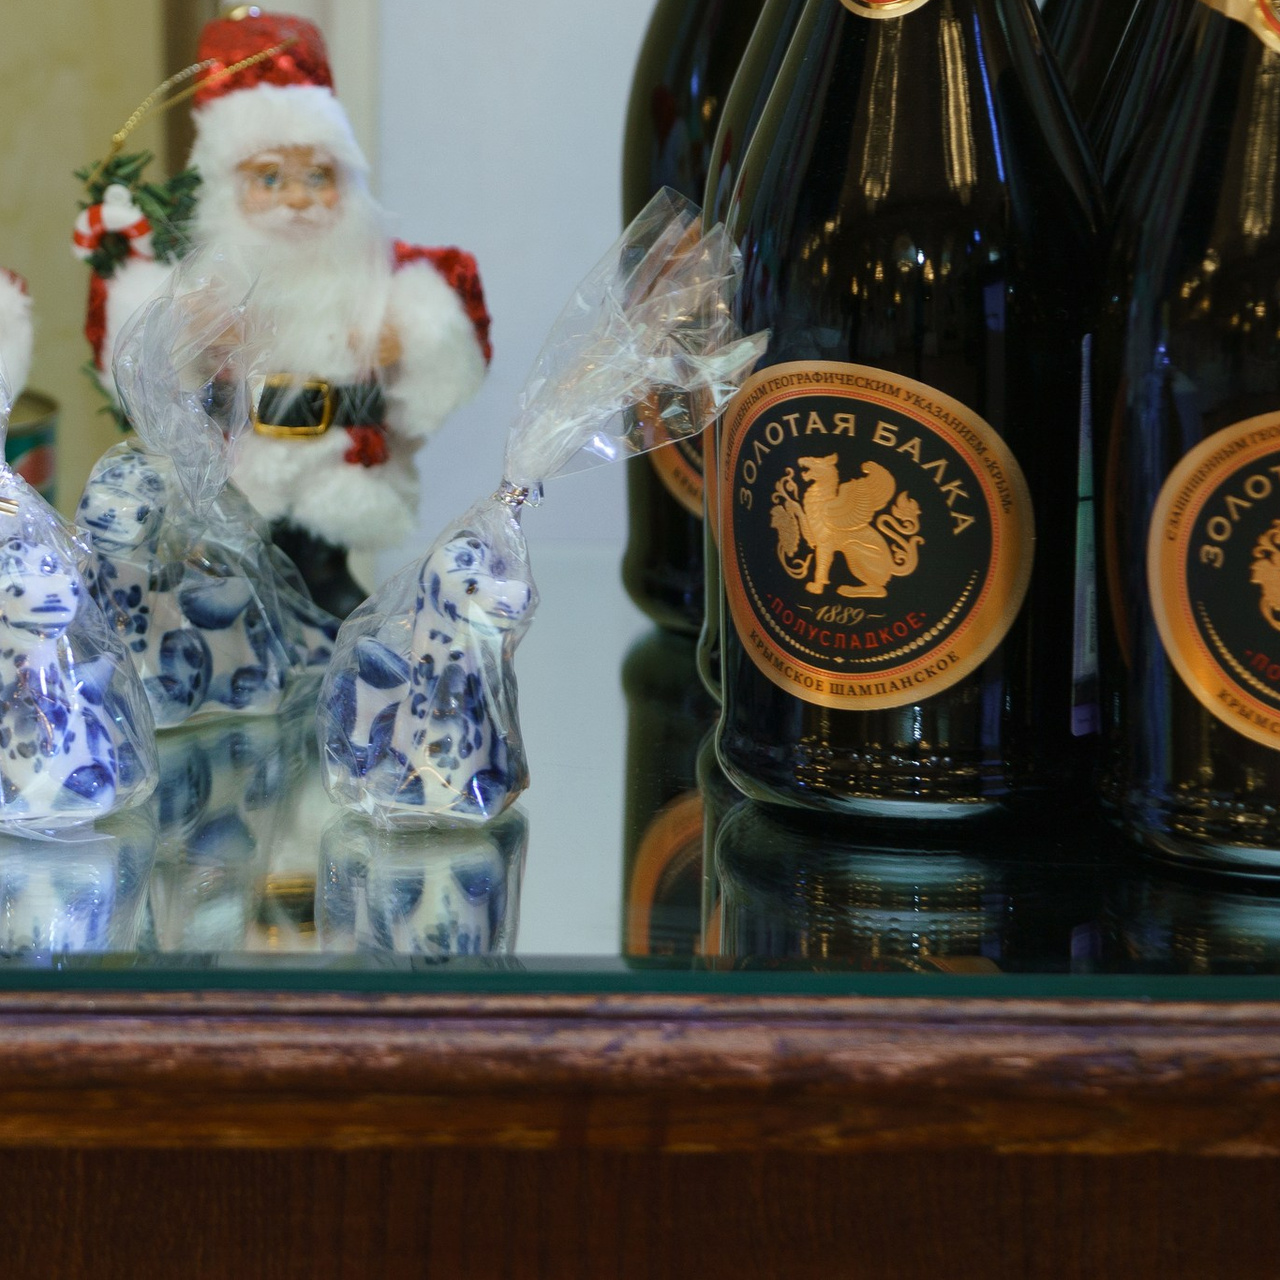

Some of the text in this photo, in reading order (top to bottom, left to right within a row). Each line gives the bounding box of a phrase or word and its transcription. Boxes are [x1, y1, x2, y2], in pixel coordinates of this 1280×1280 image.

[769, 371, 901, 399] ГЕОГРАФИЧЕСКИМ
[903, 391, 988, 456] УКАЗАНИЕМ
[740, 411, 976, 536] ЗОЛОТАЯ БАЛКА
[770, 596, 924, 650] ПОЛУСЛАДКОЕ
[815, 603, 867, 625] 1889
[749, 630, 960, 697] КРЫМСКОЕ ШАМПАНСКОЕ
